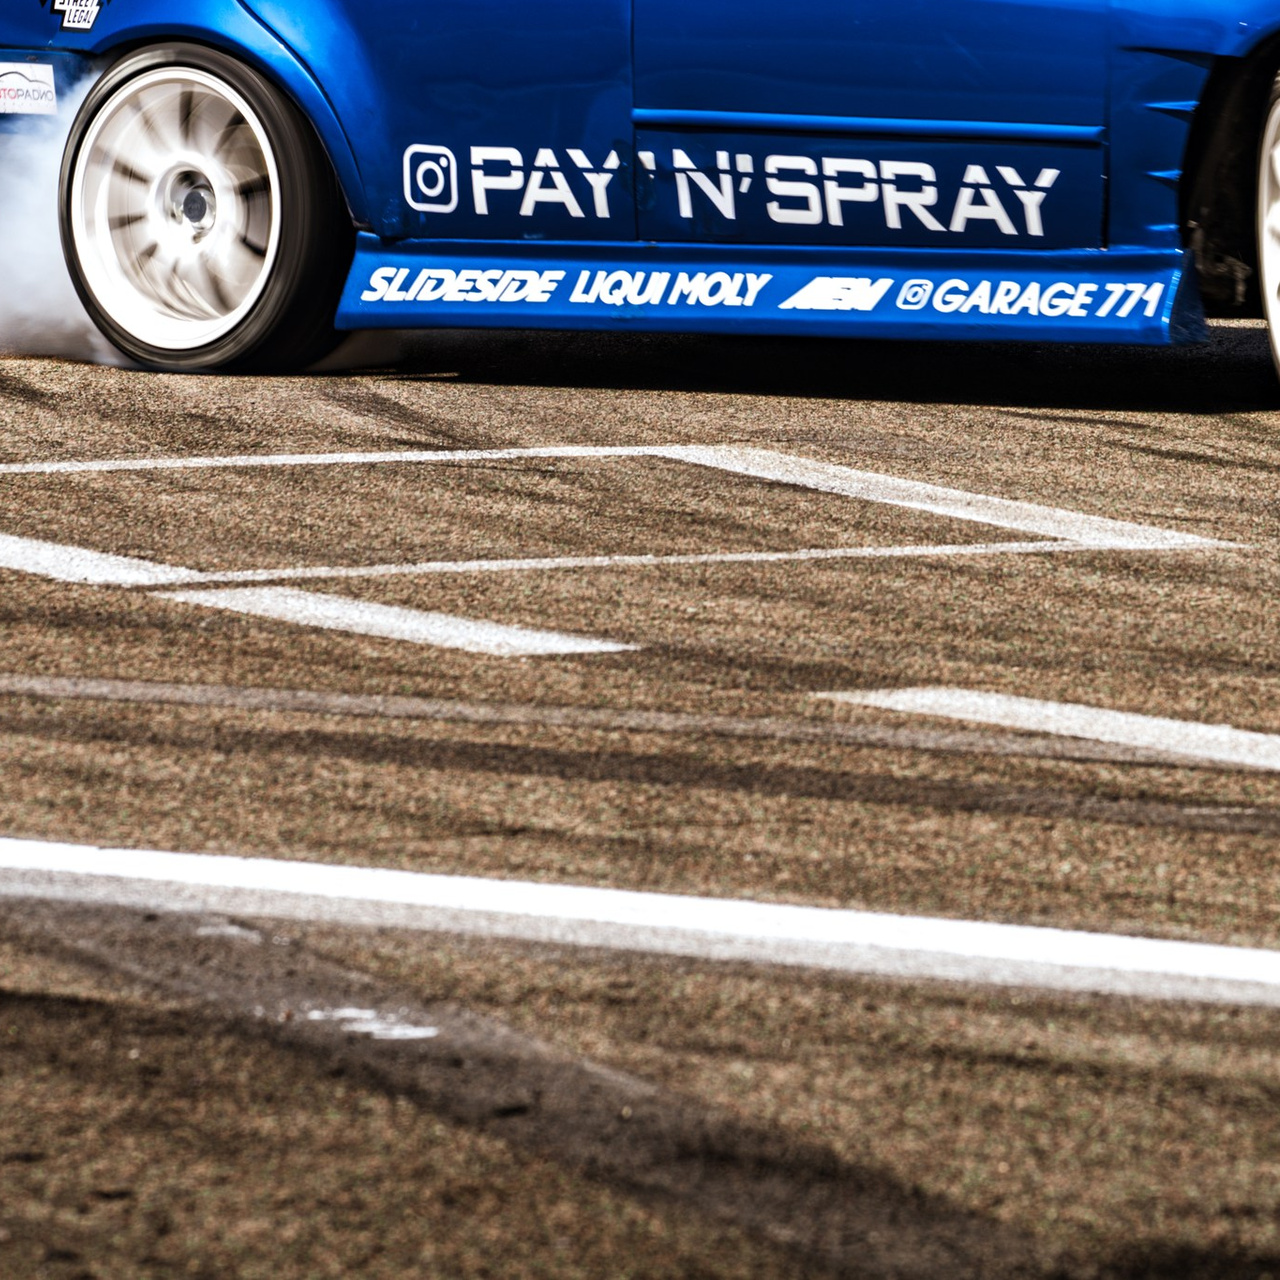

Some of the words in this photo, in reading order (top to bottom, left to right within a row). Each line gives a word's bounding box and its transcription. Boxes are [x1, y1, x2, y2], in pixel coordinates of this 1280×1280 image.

[67, 7, 94, 24] LEGAL
[360, 267, 567, 302] SLIDESIDE
[569, 270, 671, 306] LIQUI
[667, 271, 774, 307] MOLY
[932, 278, 1099, 317] GARAGE
